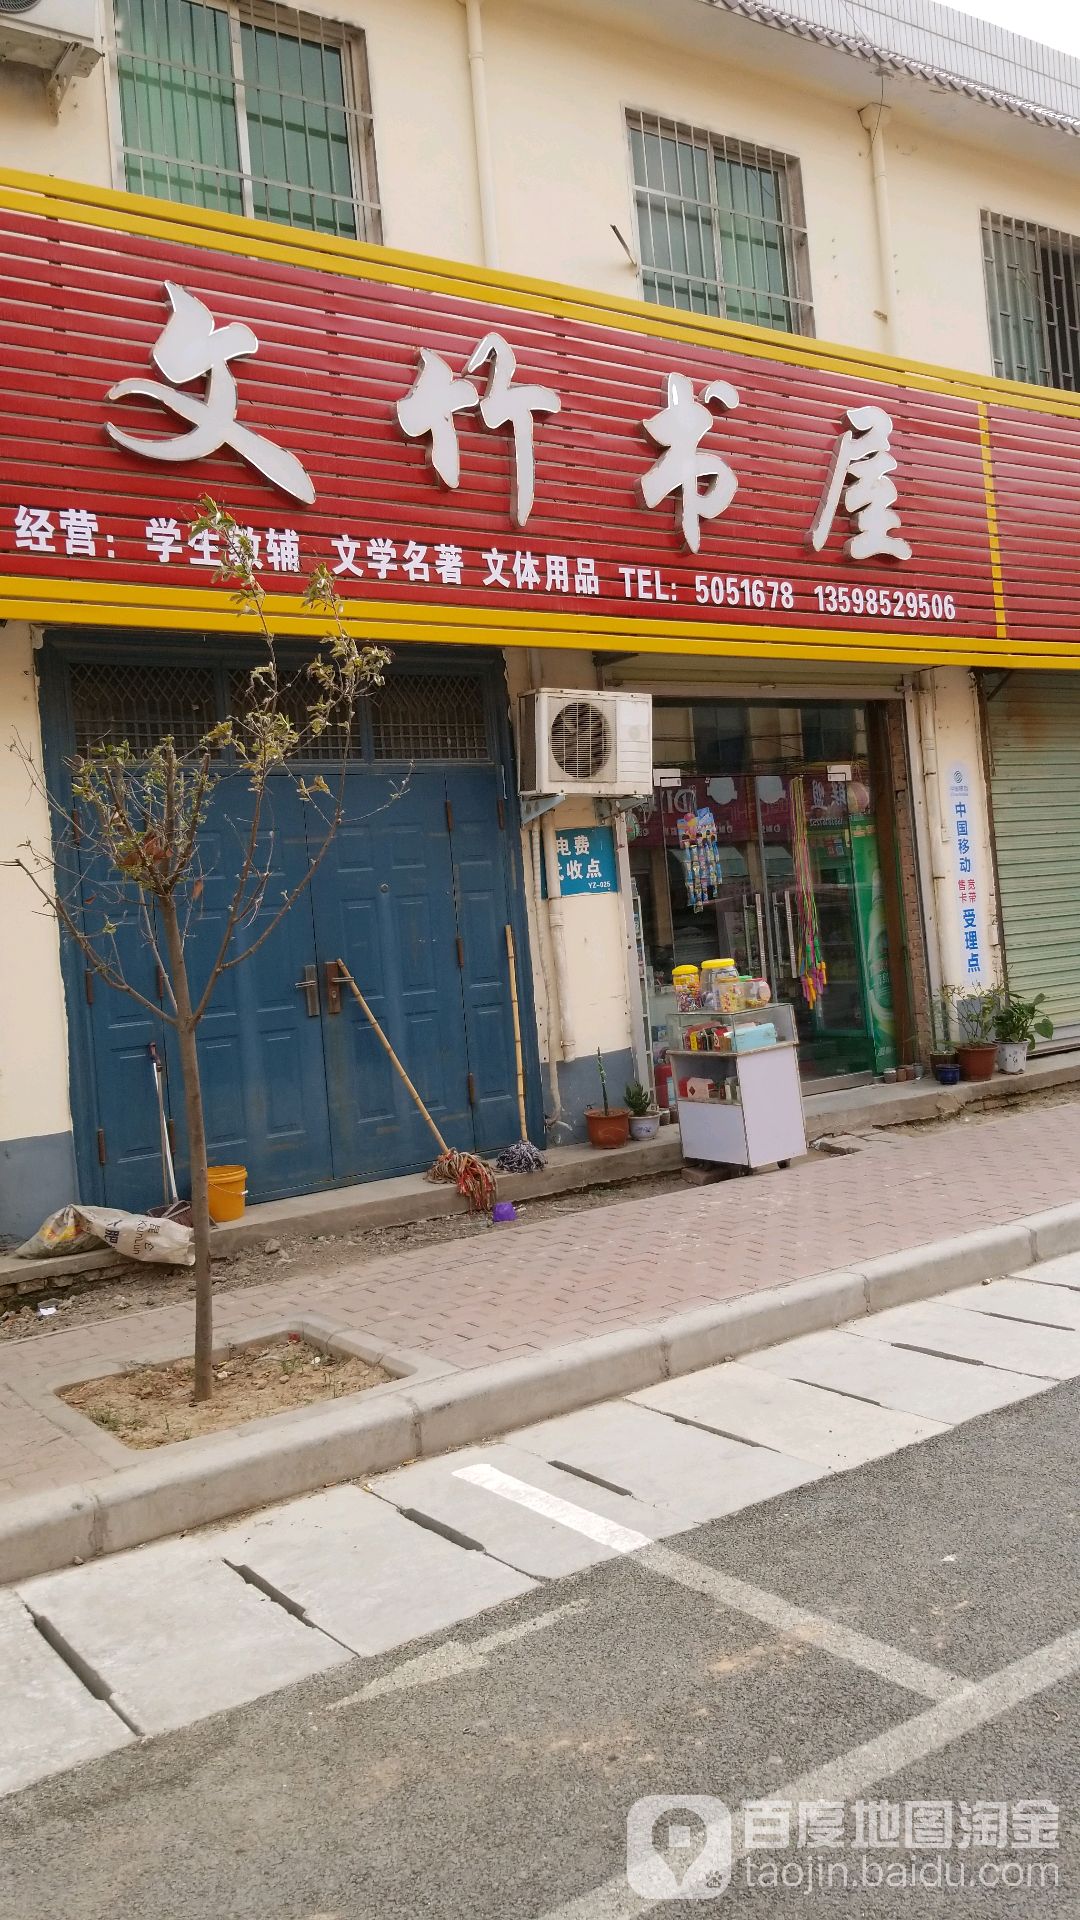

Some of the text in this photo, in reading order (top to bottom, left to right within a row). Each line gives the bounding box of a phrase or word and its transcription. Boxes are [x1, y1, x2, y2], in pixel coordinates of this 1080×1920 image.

[103, 279, 912, 561] 文竹书屋
[331, 534, 464, 585] 文学名著
[482, 548, 599, 595] 文体用品
[618, 567, 678, 602] TEL:
[695, 575, 794, 609] 5051678
[814, 585, 956, 620] 13598529506
[955, 801, 971, 873] 中国移动
[962, 908, 981, 973] 受理点
